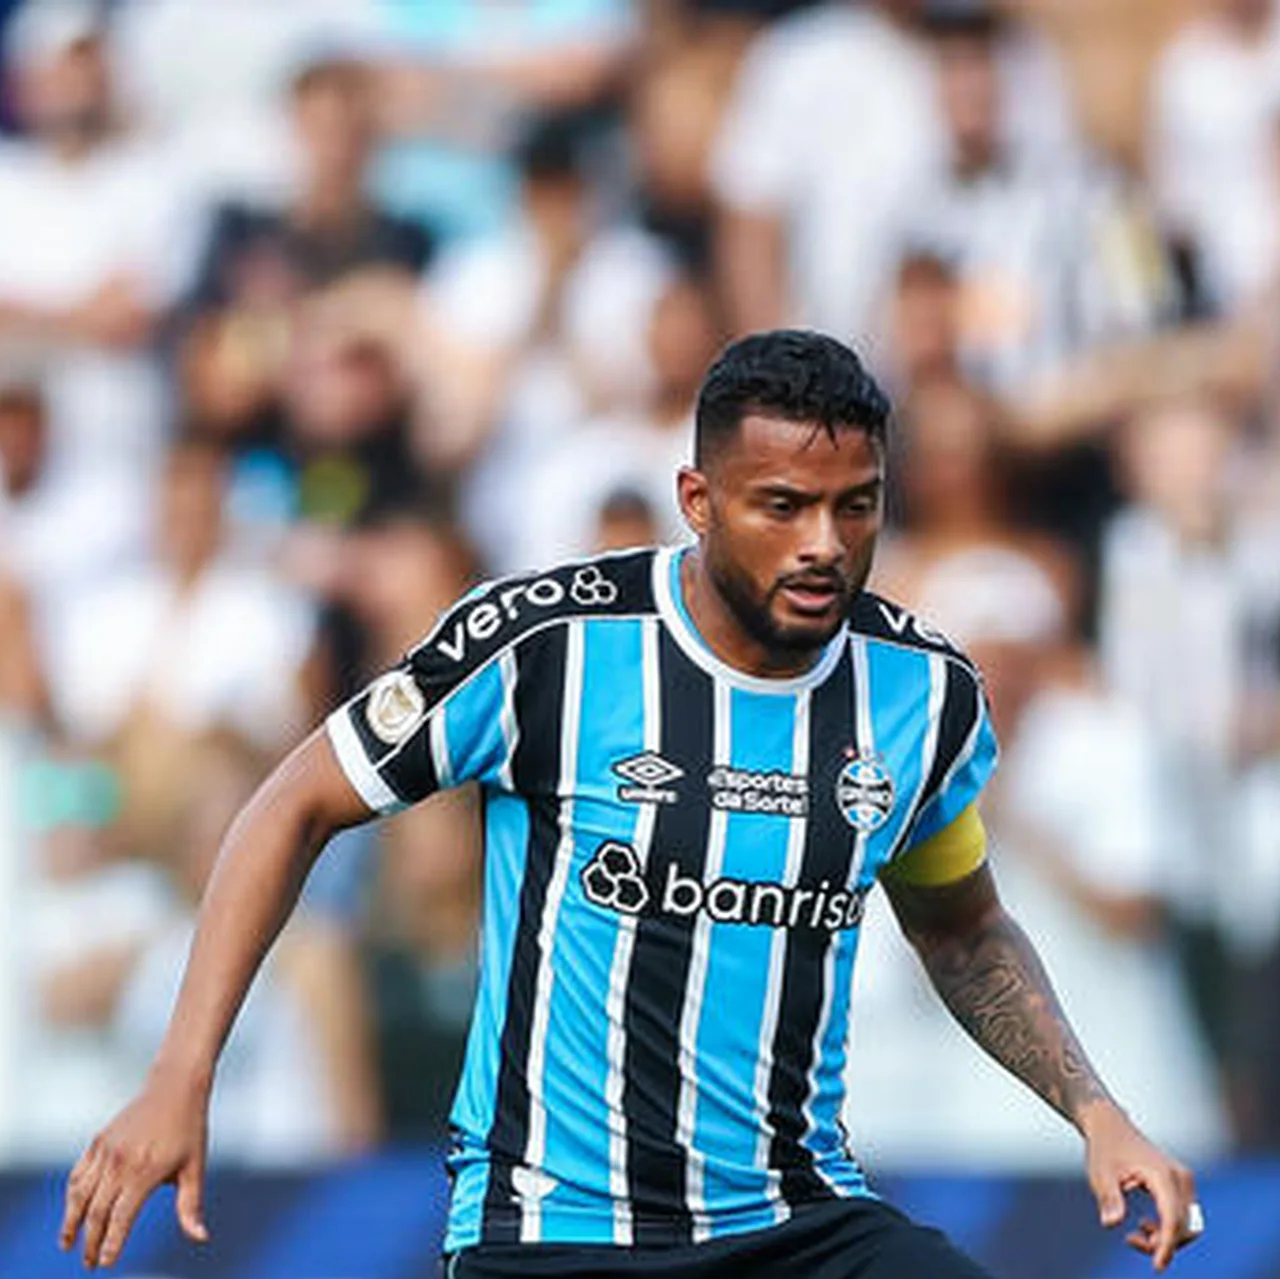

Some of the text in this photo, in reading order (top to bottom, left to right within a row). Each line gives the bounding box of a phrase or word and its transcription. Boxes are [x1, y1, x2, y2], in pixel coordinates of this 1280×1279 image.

[437, 578, 564, 661] vero
[878, 603, 946, 646] ve
[662, 861, 866, 929] banrisu
